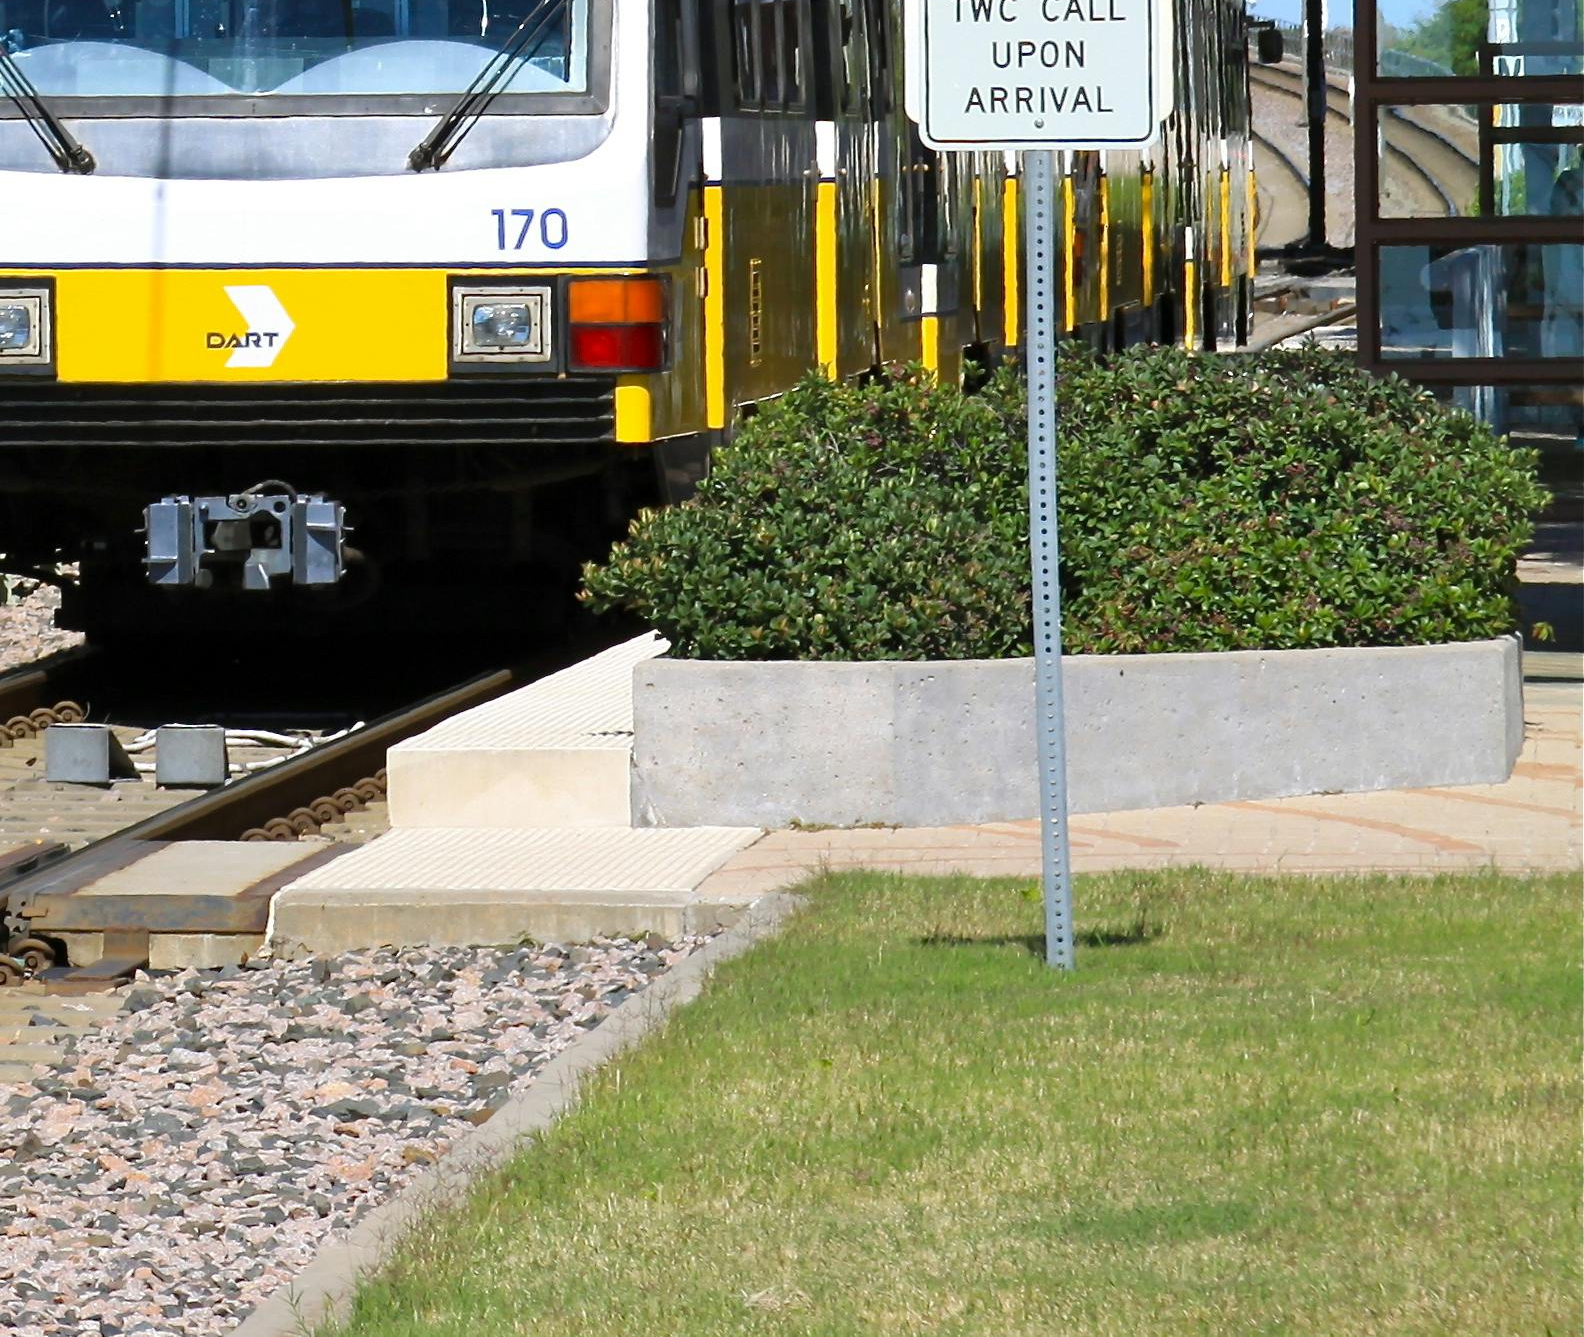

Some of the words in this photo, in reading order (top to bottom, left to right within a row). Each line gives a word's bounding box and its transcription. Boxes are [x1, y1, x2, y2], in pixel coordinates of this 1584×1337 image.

[992, 40, 1086, 69] UPON
[964, 86, 1114, 114] ARRIVAL
[491, 207, 569, 250] 170
[206, 332, 279, 349] DART
